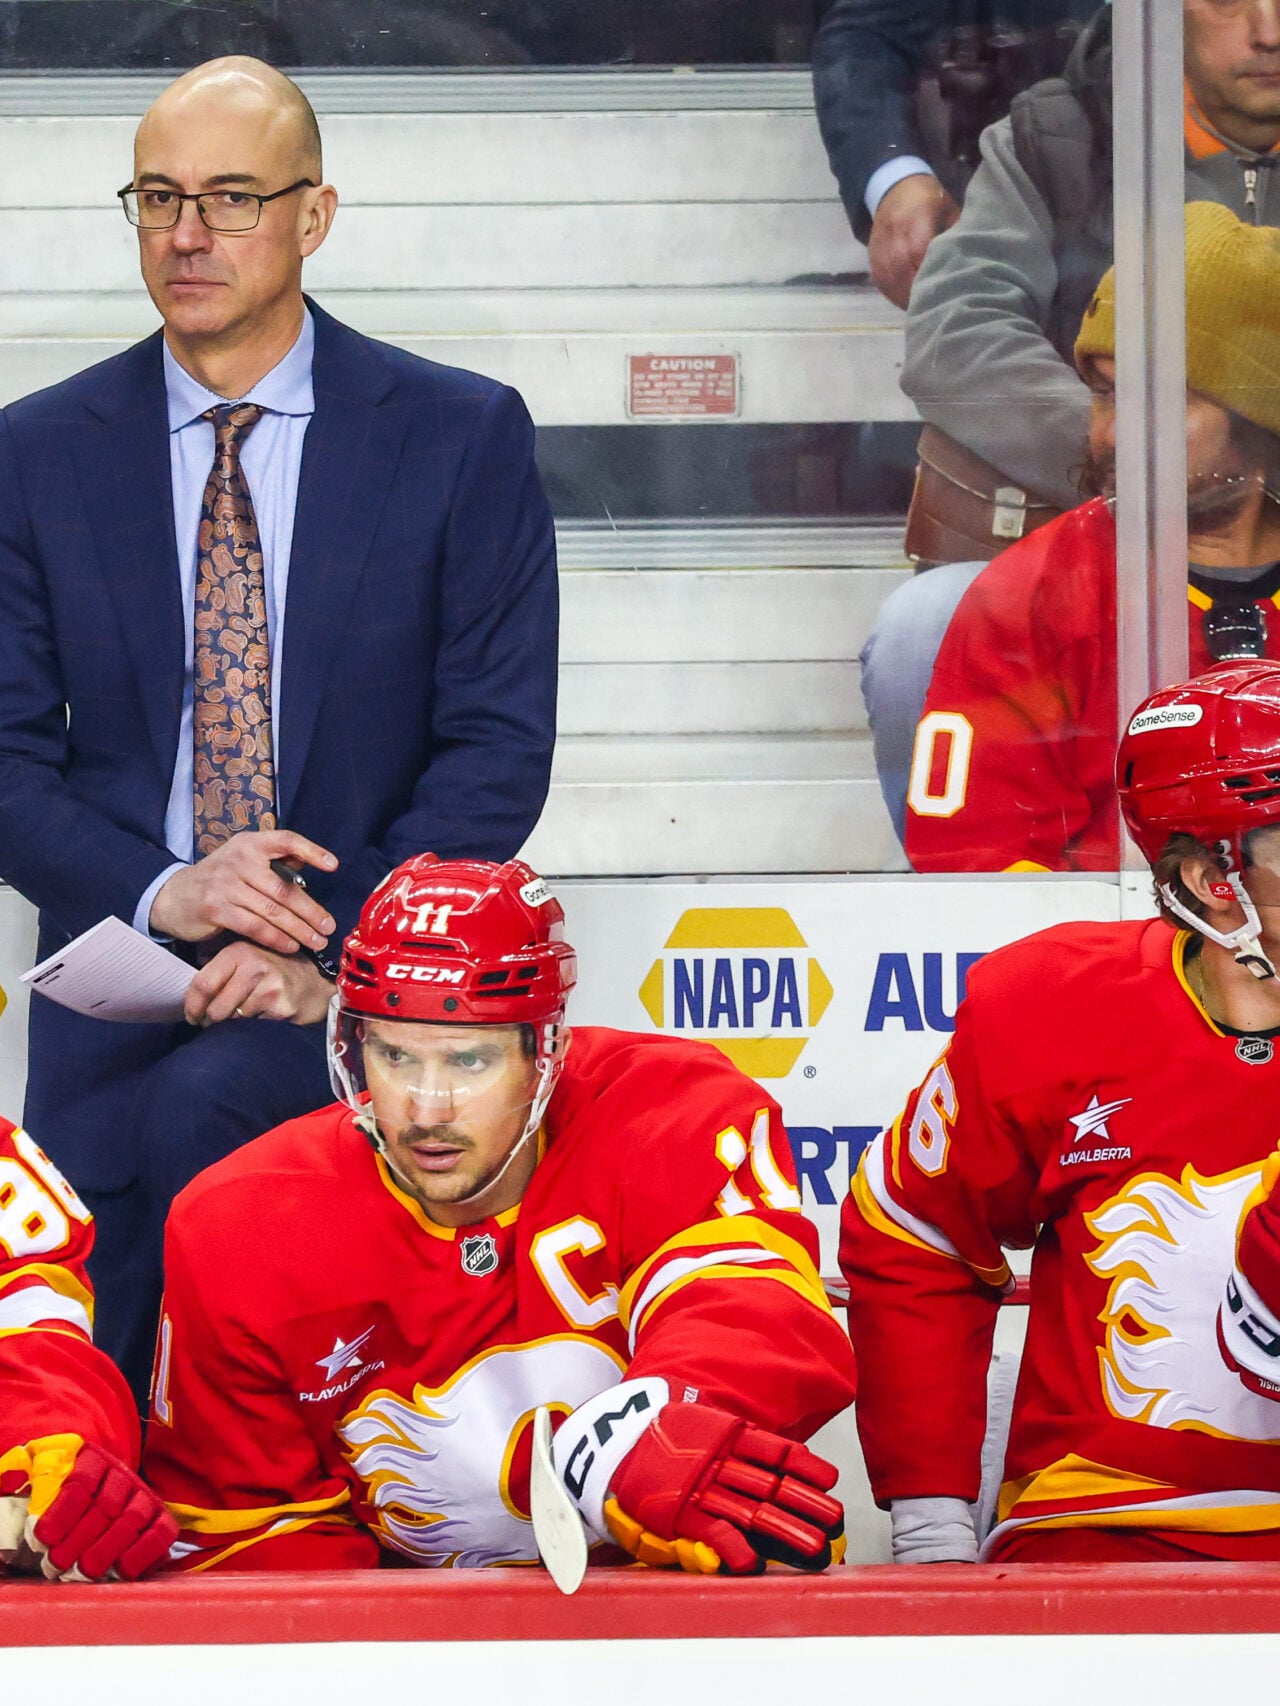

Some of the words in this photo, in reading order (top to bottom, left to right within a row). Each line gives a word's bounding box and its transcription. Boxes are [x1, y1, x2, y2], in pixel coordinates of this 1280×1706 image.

[650, 359, 715, 370] CAUTION
[1132, 710, 1196, 729] GameSense
[413, 902, 452, 934] 11
[386, 964, 467, 984] CCM
[674, 958, 803, 1029] NAPA
[864, 953, 989, 1032] AU
[1243, 1042, 1266, 1056] NHL
[469, 1244, 490, 1269] NHL
[529, 1214, 621, 1331] C
[299, 1361, 385, 1401] PLAYALBERTA
[563, 1390, 651, 1520] CM
